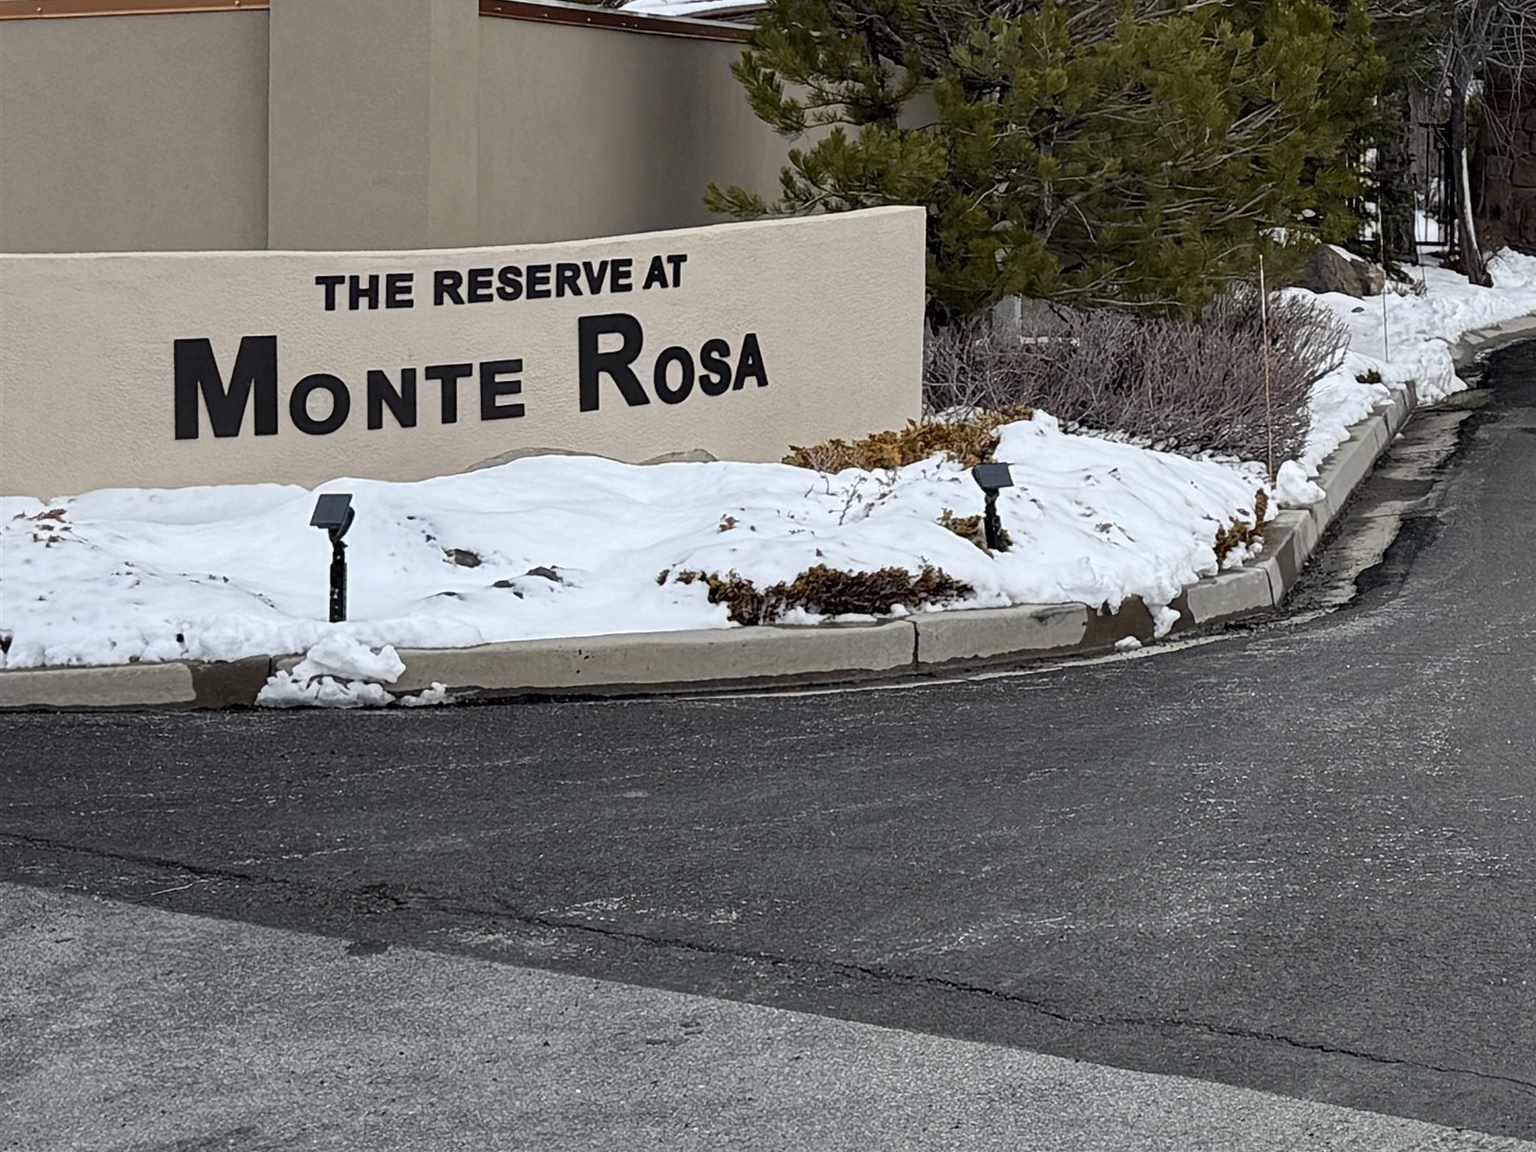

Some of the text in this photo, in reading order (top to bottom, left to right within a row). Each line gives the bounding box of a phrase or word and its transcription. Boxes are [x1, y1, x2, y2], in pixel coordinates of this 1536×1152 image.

[314, 253, 688, 312] THE RESERVE AT
